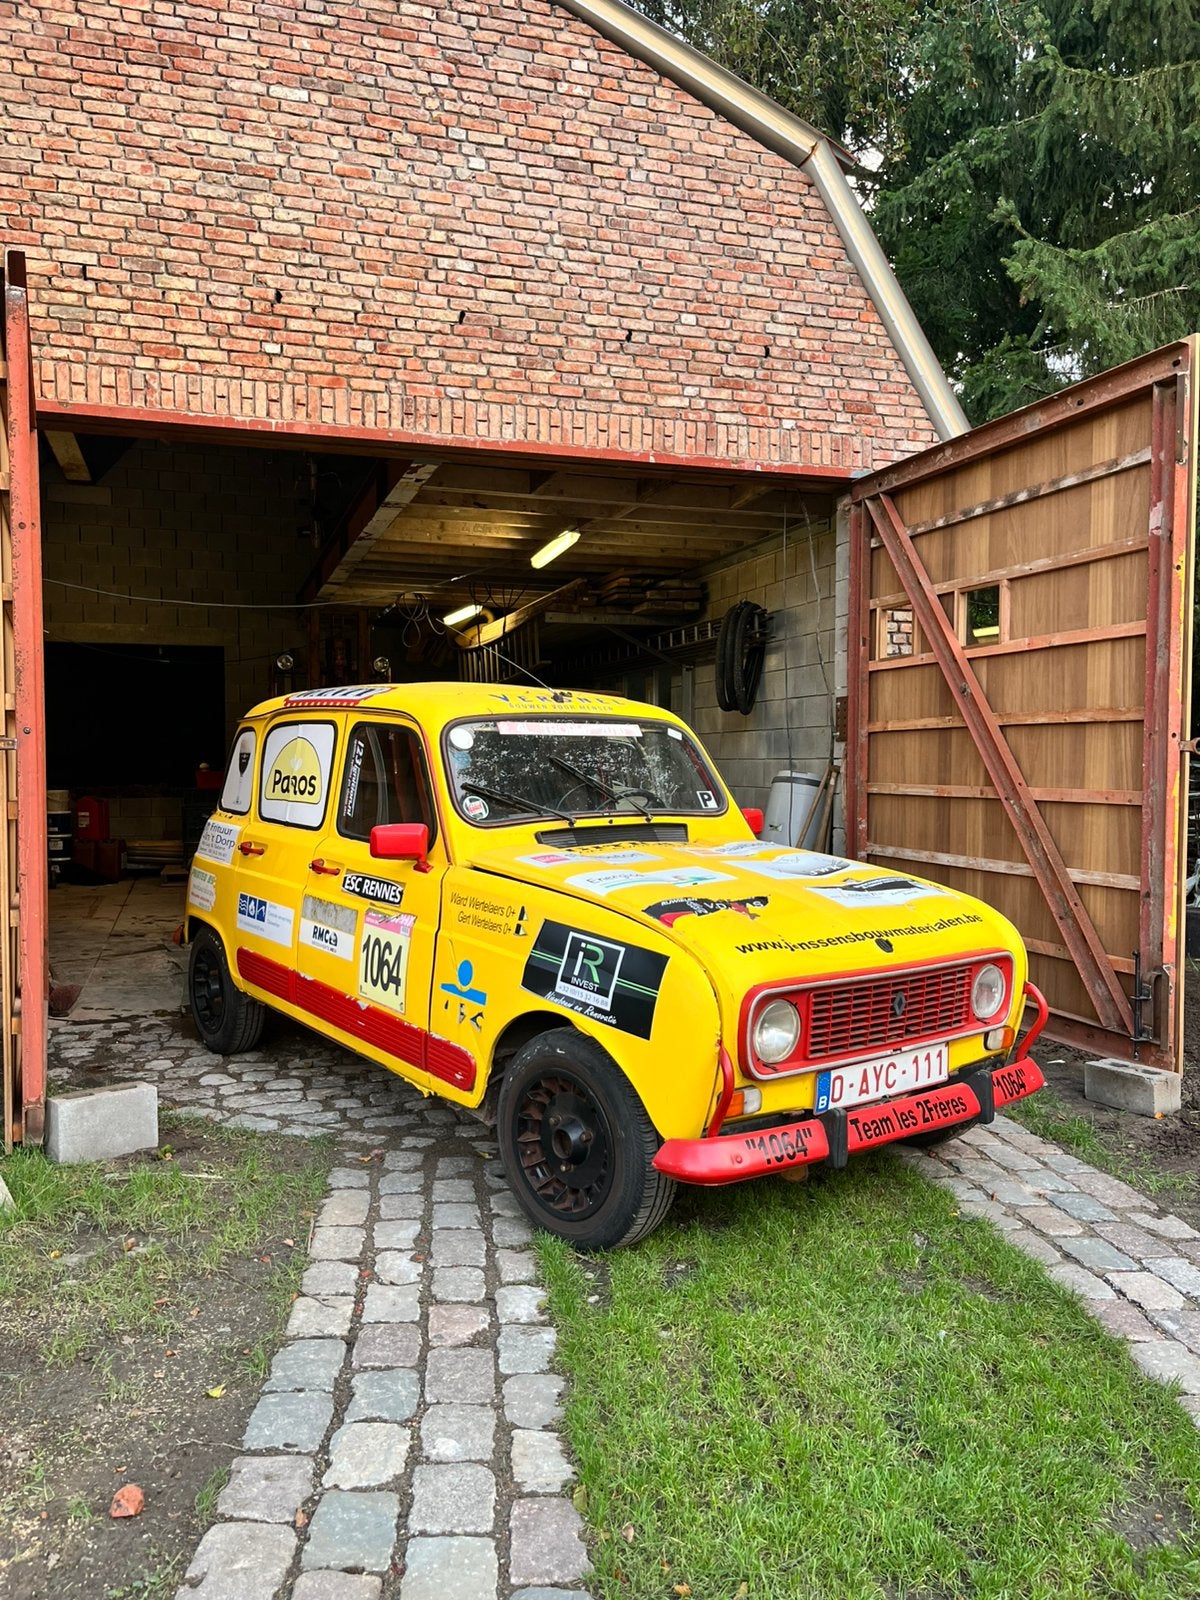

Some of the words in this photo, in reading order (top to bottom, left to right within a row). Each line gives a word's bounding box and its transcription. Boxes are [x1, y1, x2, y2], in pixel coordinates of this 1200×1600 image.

[699, 792, 712, 807] P
[210, 822, 233, 837] Frituur
[215, 834, 236, 849] Dorp
[344, 876, 362, 893] ESC
[362, 879, 401, 903] RENNES
[450, 891, 468, 907] Ward
[468, 896, 504, 917] Wertelaers
[458, 910, 471, 925] Gert
[471, 913, 502, 934] Wertelaers
[362, 934, 402, 996] 1064
[571, 976, 599, 992] INVEST
[819, 1095, 828, 1109] B
[849, 1114, 895, 1142] Team
[891, 1107, 919, 1130] les
[915, 1096, 968, 1124] 2Frères
